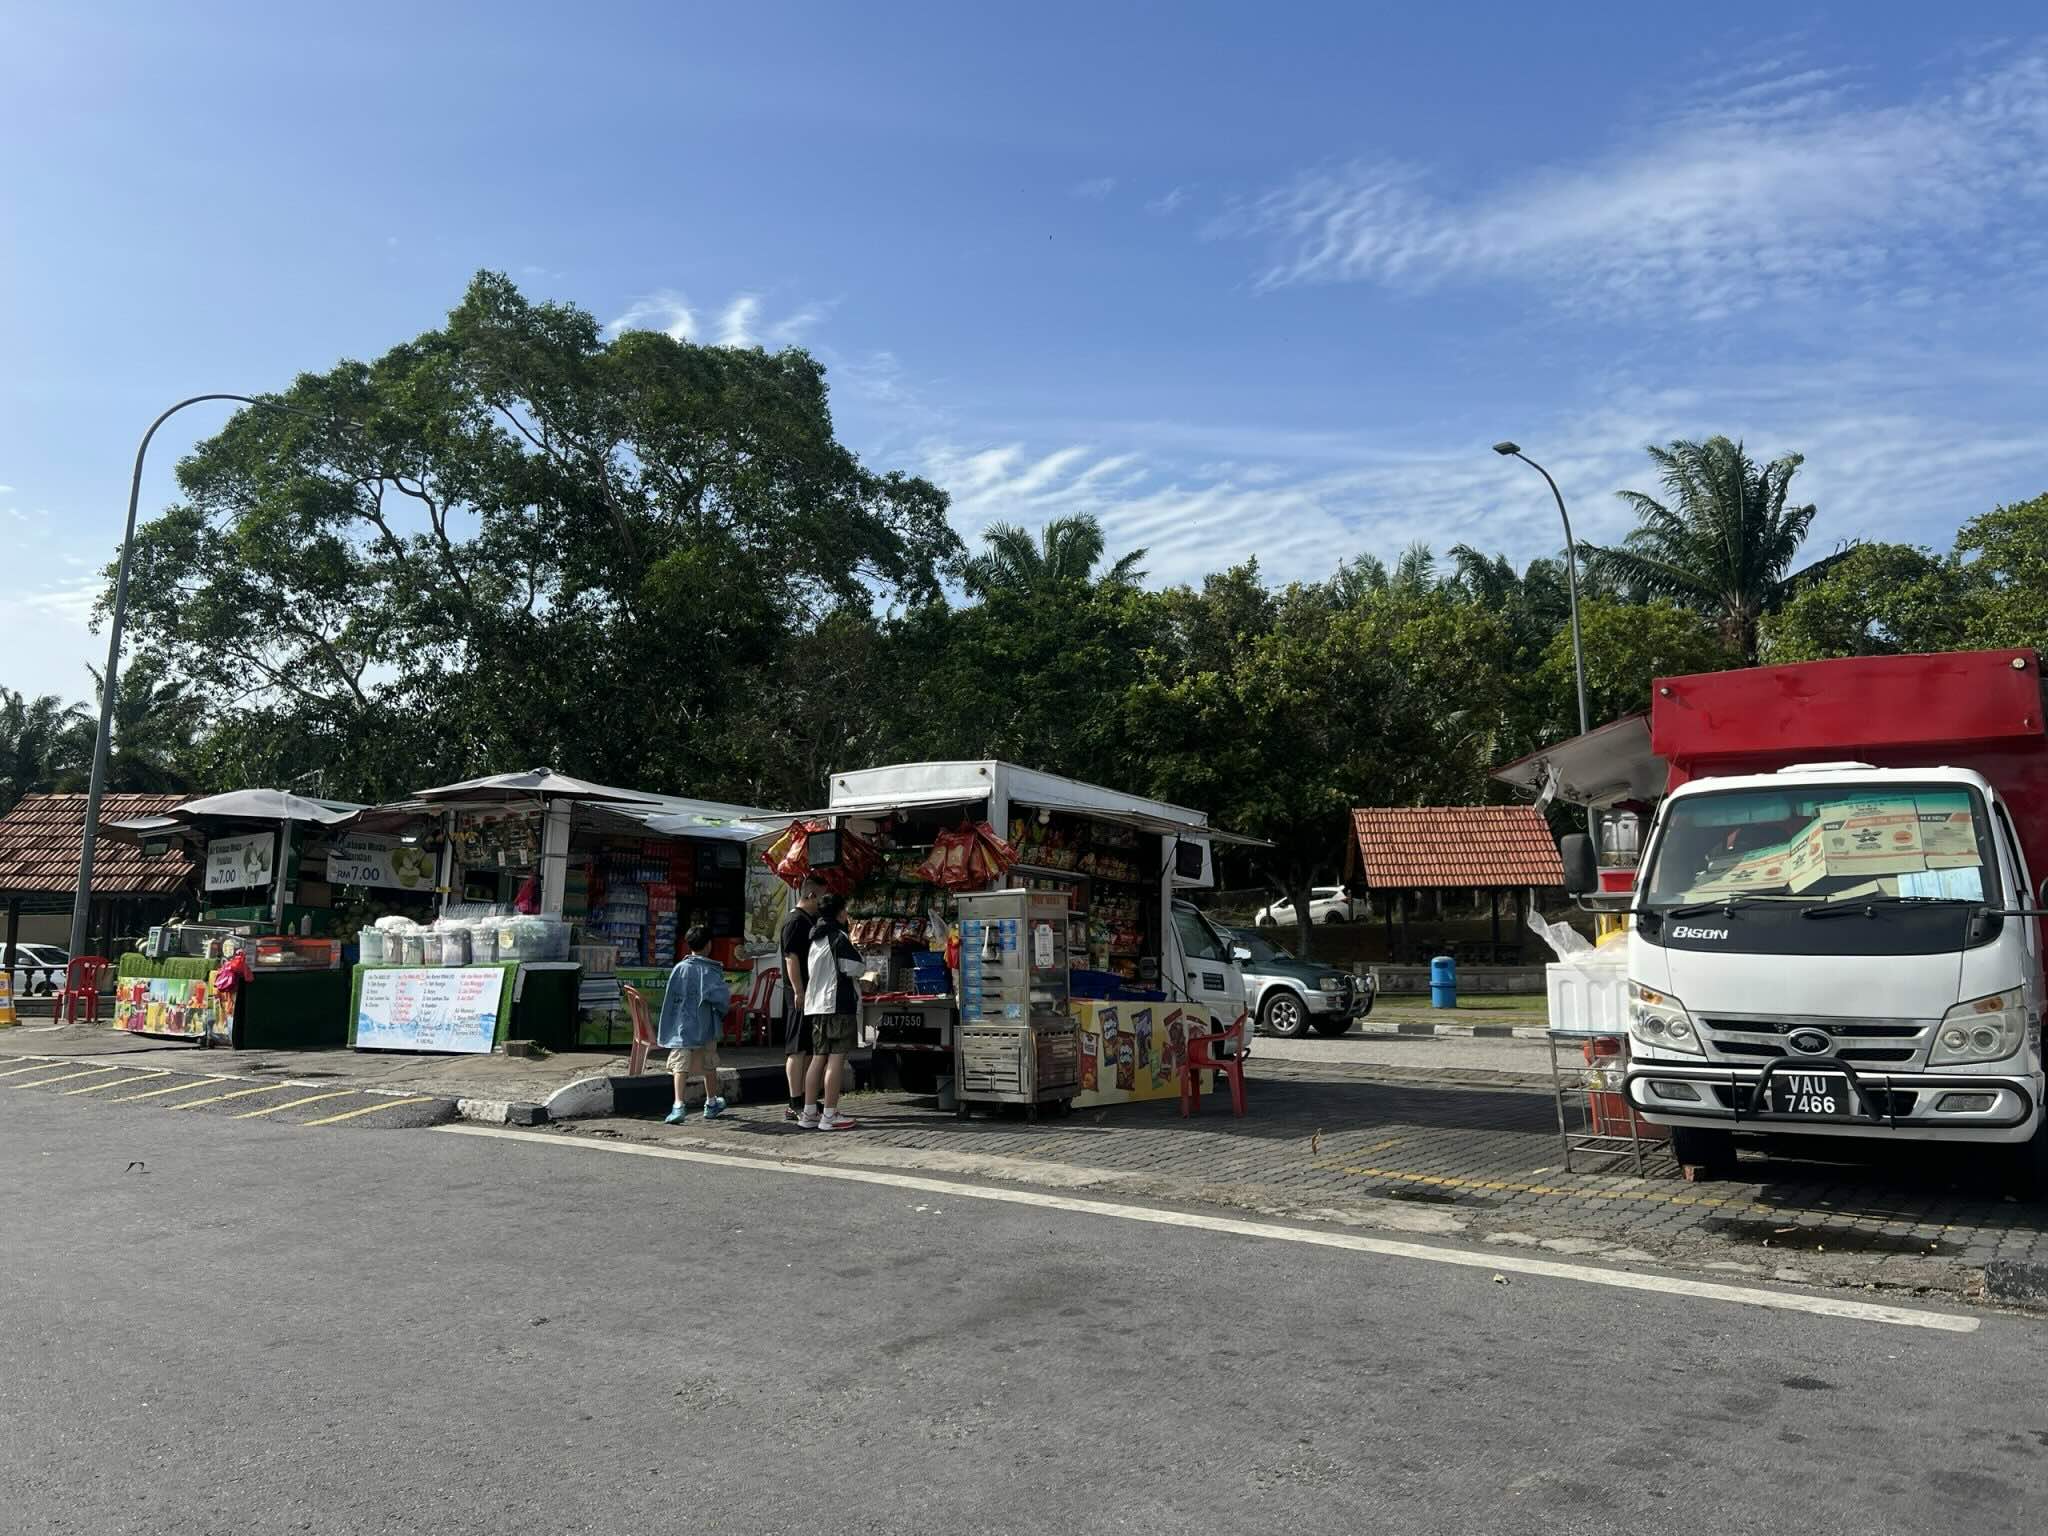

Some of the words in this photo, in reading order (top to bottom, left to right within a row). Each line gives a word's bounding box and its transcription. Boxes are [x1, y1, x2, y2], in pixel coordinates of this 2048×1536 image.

[1672, 925, 1729, 940] BISON
[1788, 1075, 1828, 1095] VAU
[1784, 1094, 1836, 1114] 7466
